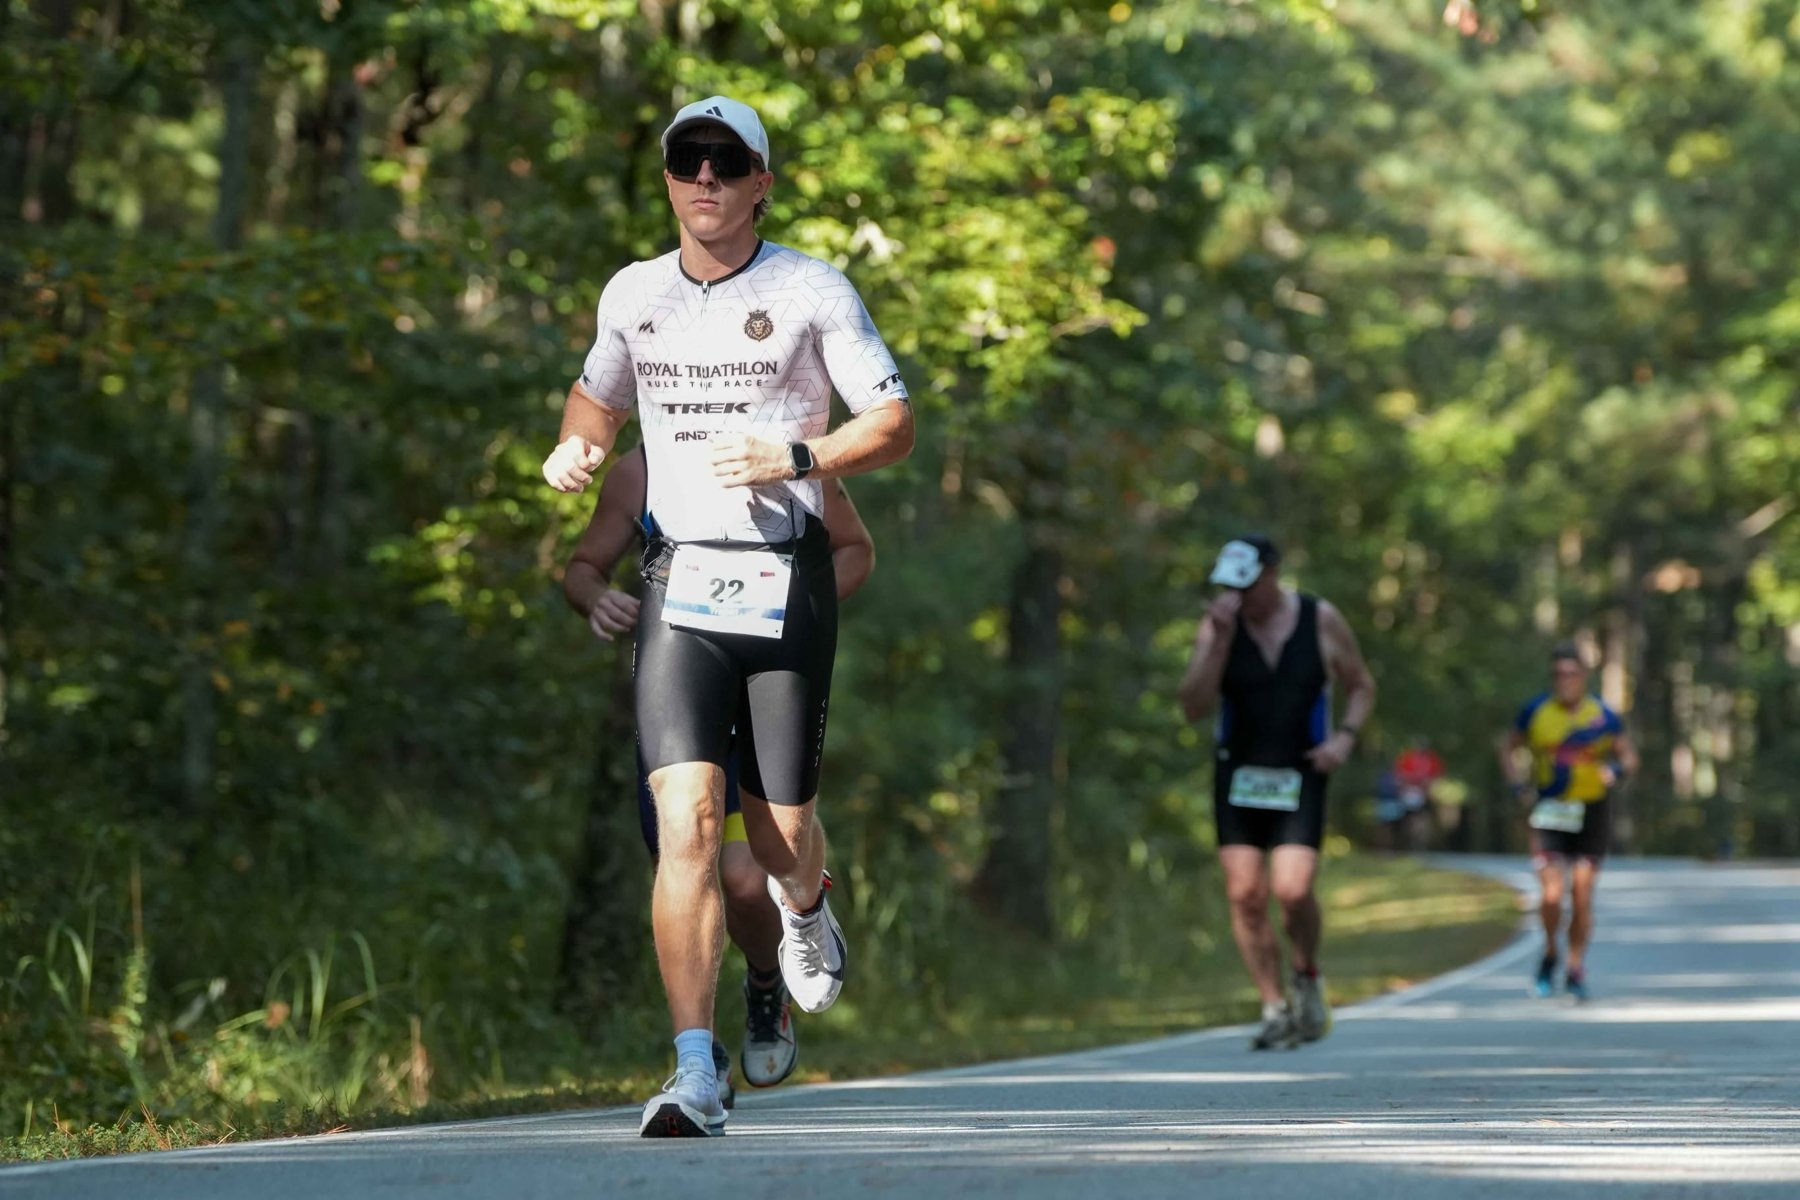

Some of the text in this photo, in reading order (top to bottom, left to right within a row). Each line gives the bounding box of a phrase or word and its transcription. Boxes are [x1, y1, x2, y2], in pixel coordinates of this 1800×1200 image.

[637, 361, 778, 378] ROYAL TRIATHLON
[648, 380, 679, 388] RULE
[725, 379, 762, 388] RACE
[662, 402, 751, 414] TREK
[709, 578, 745, 603] 22
